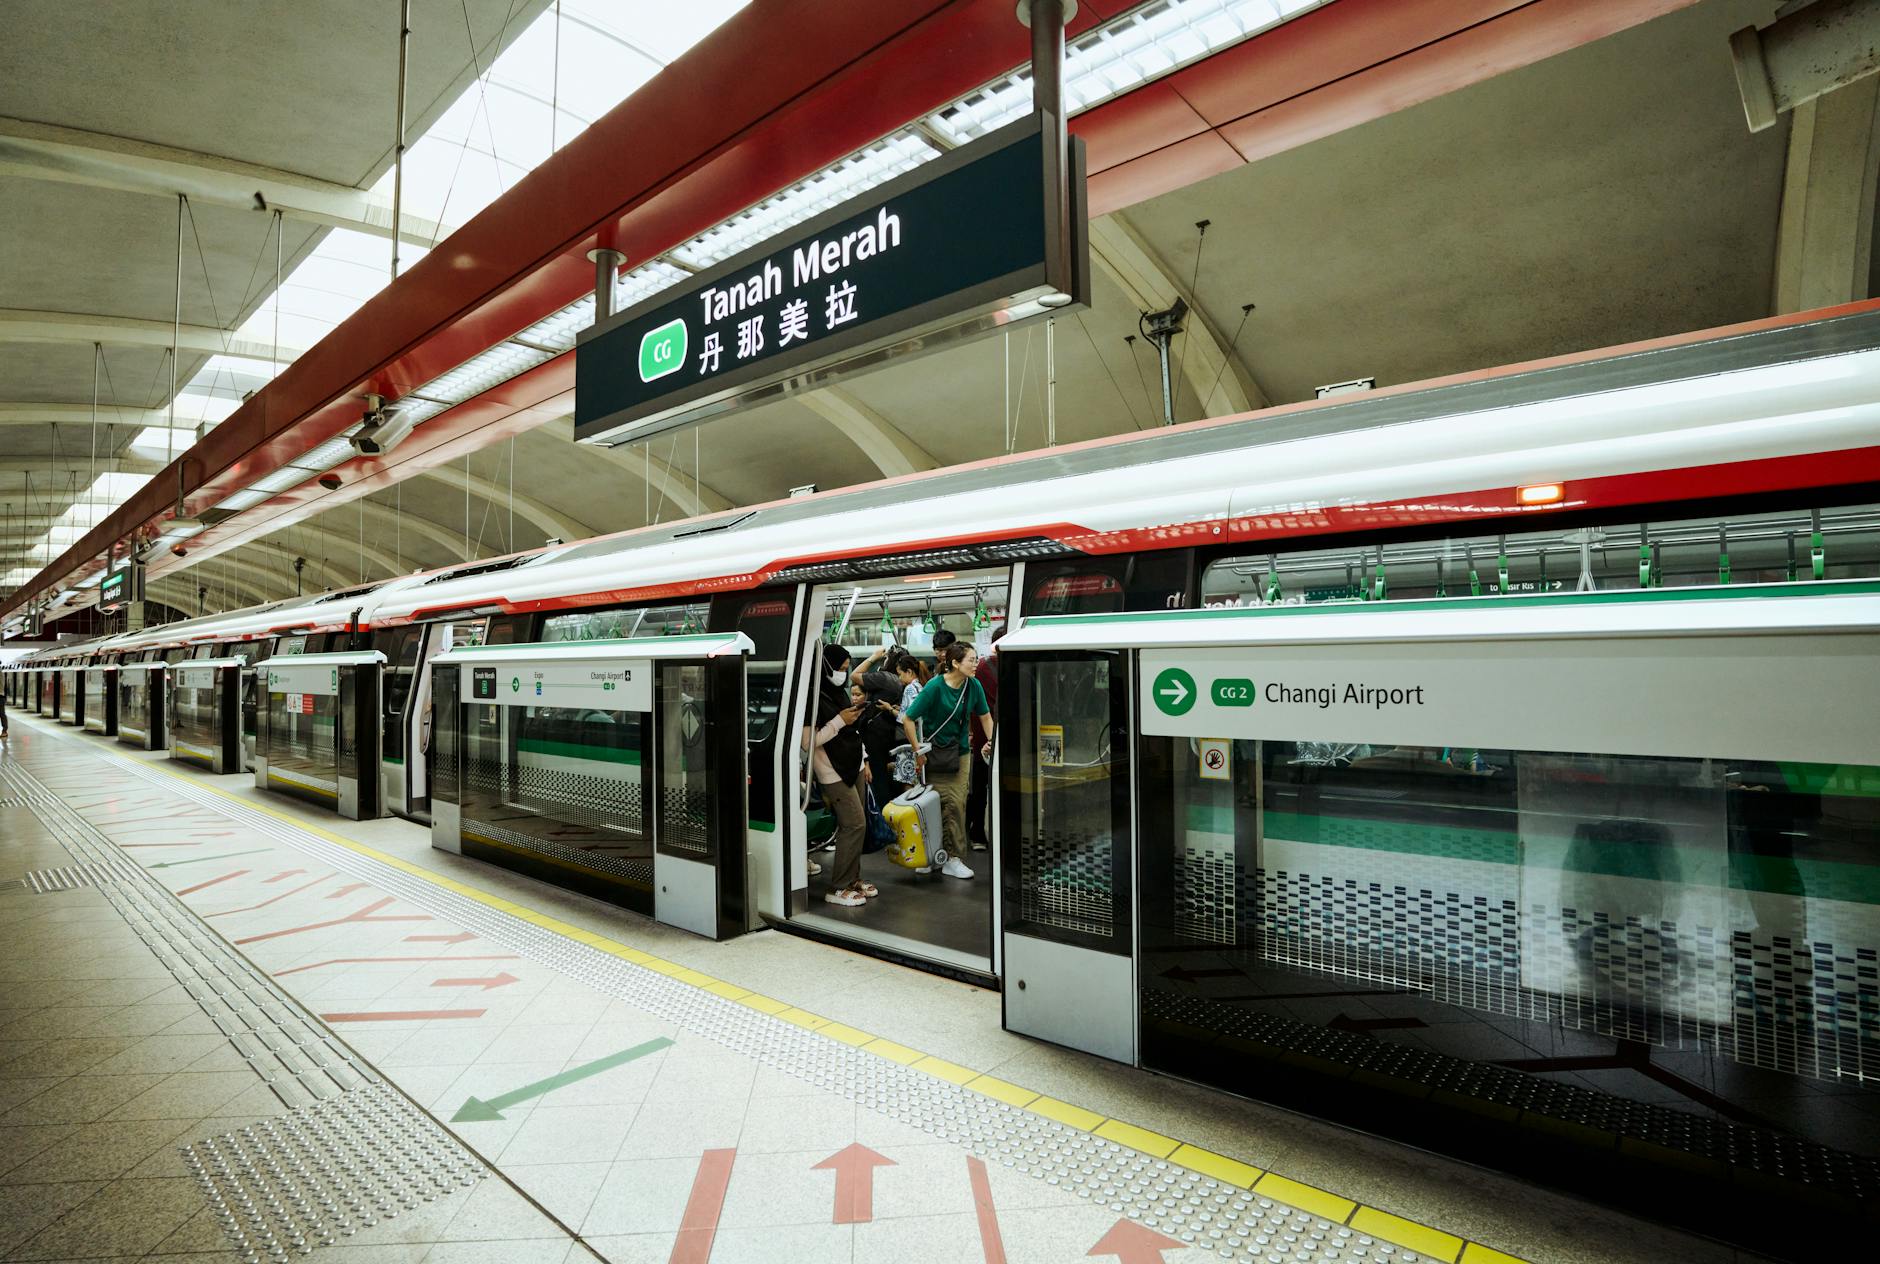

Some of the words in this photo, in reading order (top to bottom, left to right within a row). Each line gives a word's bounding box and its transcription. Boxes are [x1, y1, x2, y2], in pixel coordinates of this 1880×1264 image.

[699, 260, 783, 325] Tanah
[791, 207, 901, 288] Merah
[698, 278, 859, 375] 丹那美拉
[652, 337, 673, 365] CG
[534, 671, 544, 681] Expo
[590, 672, 606, 681] Changi
[606, 672, 624, 681] Airport
[1219, 686, 1236, 699] CG
[1238, 686, 1248, 699] 2
[1265, 683, 1336, 709] Changi
[1343, 683, 1424, 709] Airport
